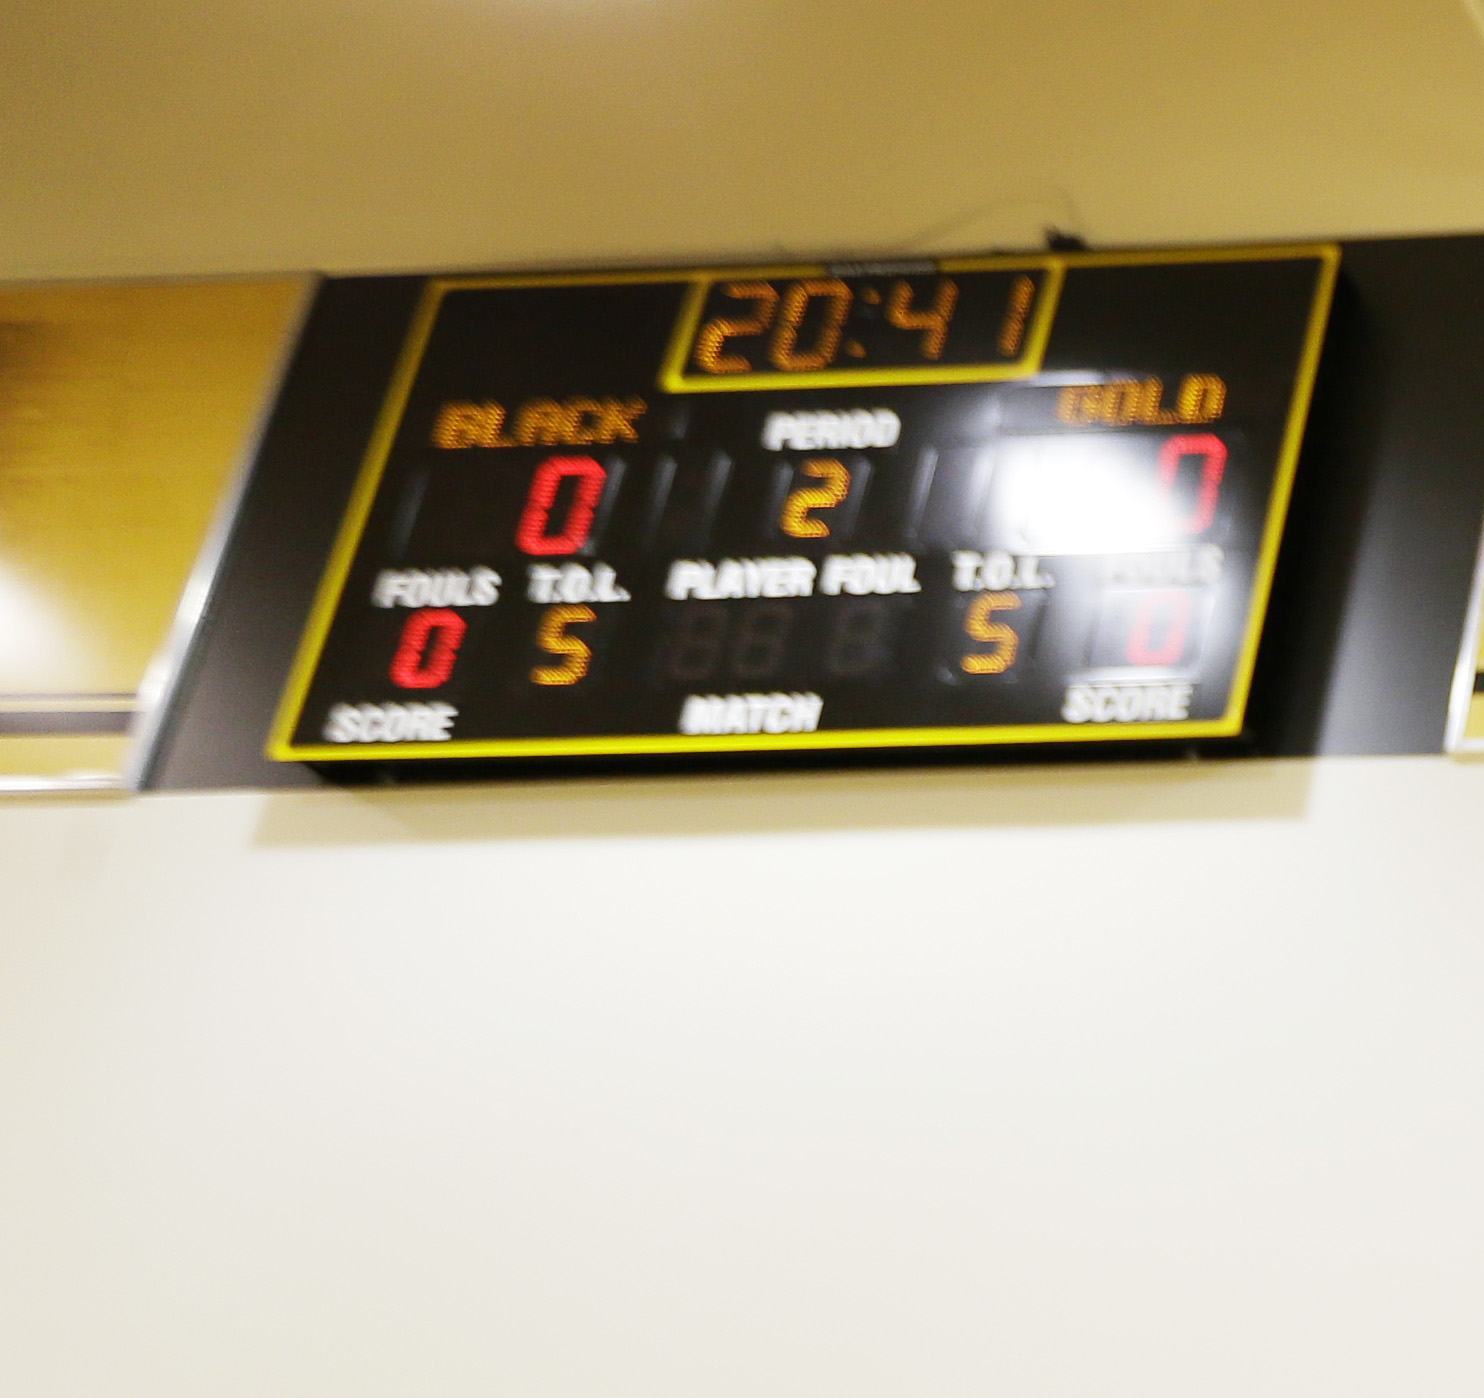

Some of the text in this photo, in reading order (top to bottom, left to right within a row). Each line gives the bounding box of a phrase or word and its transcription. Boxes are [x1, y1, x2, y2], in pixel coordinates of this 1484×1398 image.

[693, 276, 1035, 373] 20:41
[430, 397, 648, 449] BLACK
[1054, 373, 1228, 427] GOLD
[762, 409, 902, 451] PERIOD
[515, 455, 608, 556] 0
[780, 457, 852, 539] 2
[371, 565, 503, 608] FOULS
[664, 552, 922, 601] PLAYER FOUL
[390, 606, 468, 689] 0
[529, 604, 598, 686] 5
[960, 591, 1022, 675] 5
[323, 702, 459, 743] SCORE
[679, 692, 824, 735] MATCH
[1060, 683, 1194, 724] SCORE
